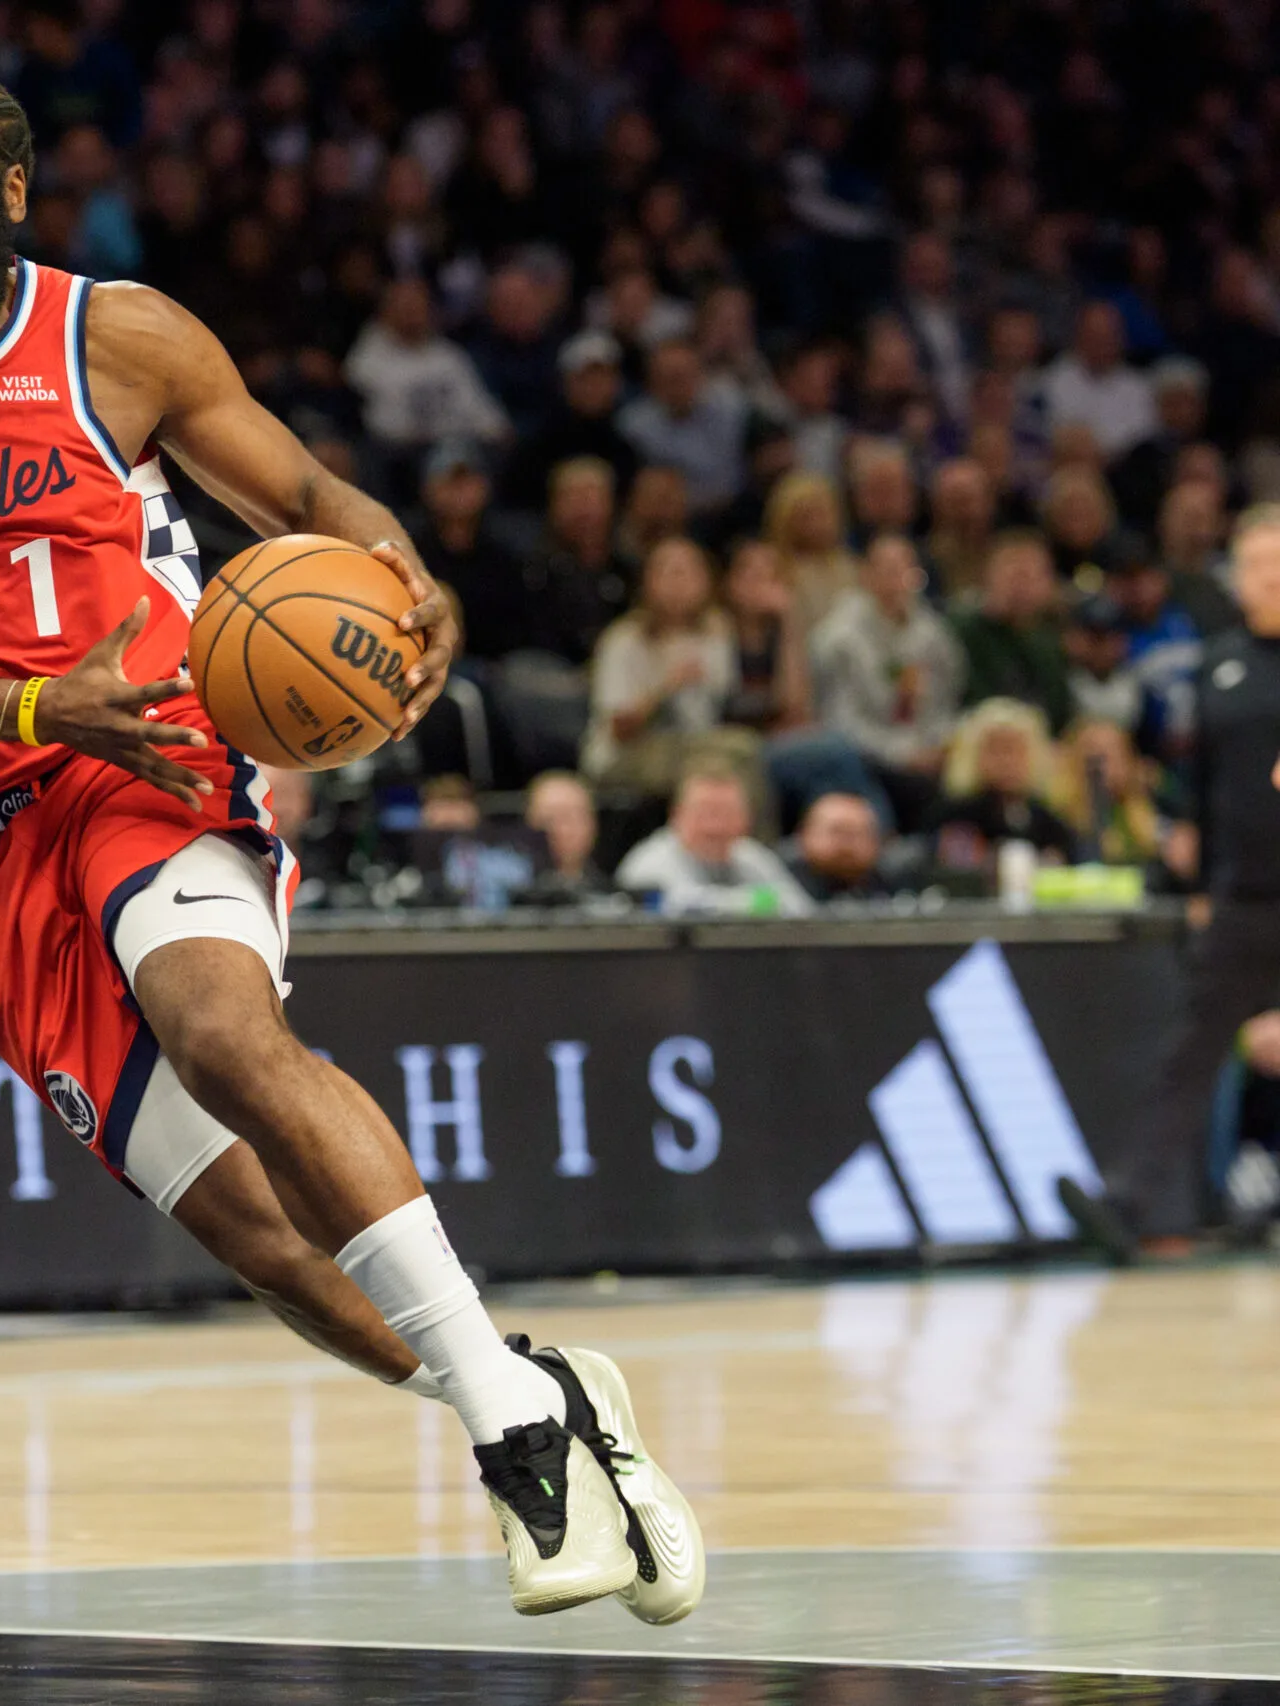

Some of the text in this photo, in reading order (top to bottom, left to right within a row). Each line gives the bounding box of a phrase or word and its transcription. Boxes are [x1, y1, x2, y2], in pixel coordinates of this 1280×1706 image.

[2, 375, 43, 389] VISIT
[10, 537, 62, 638] 1
[312, 1035, 723, 1184] HIS
